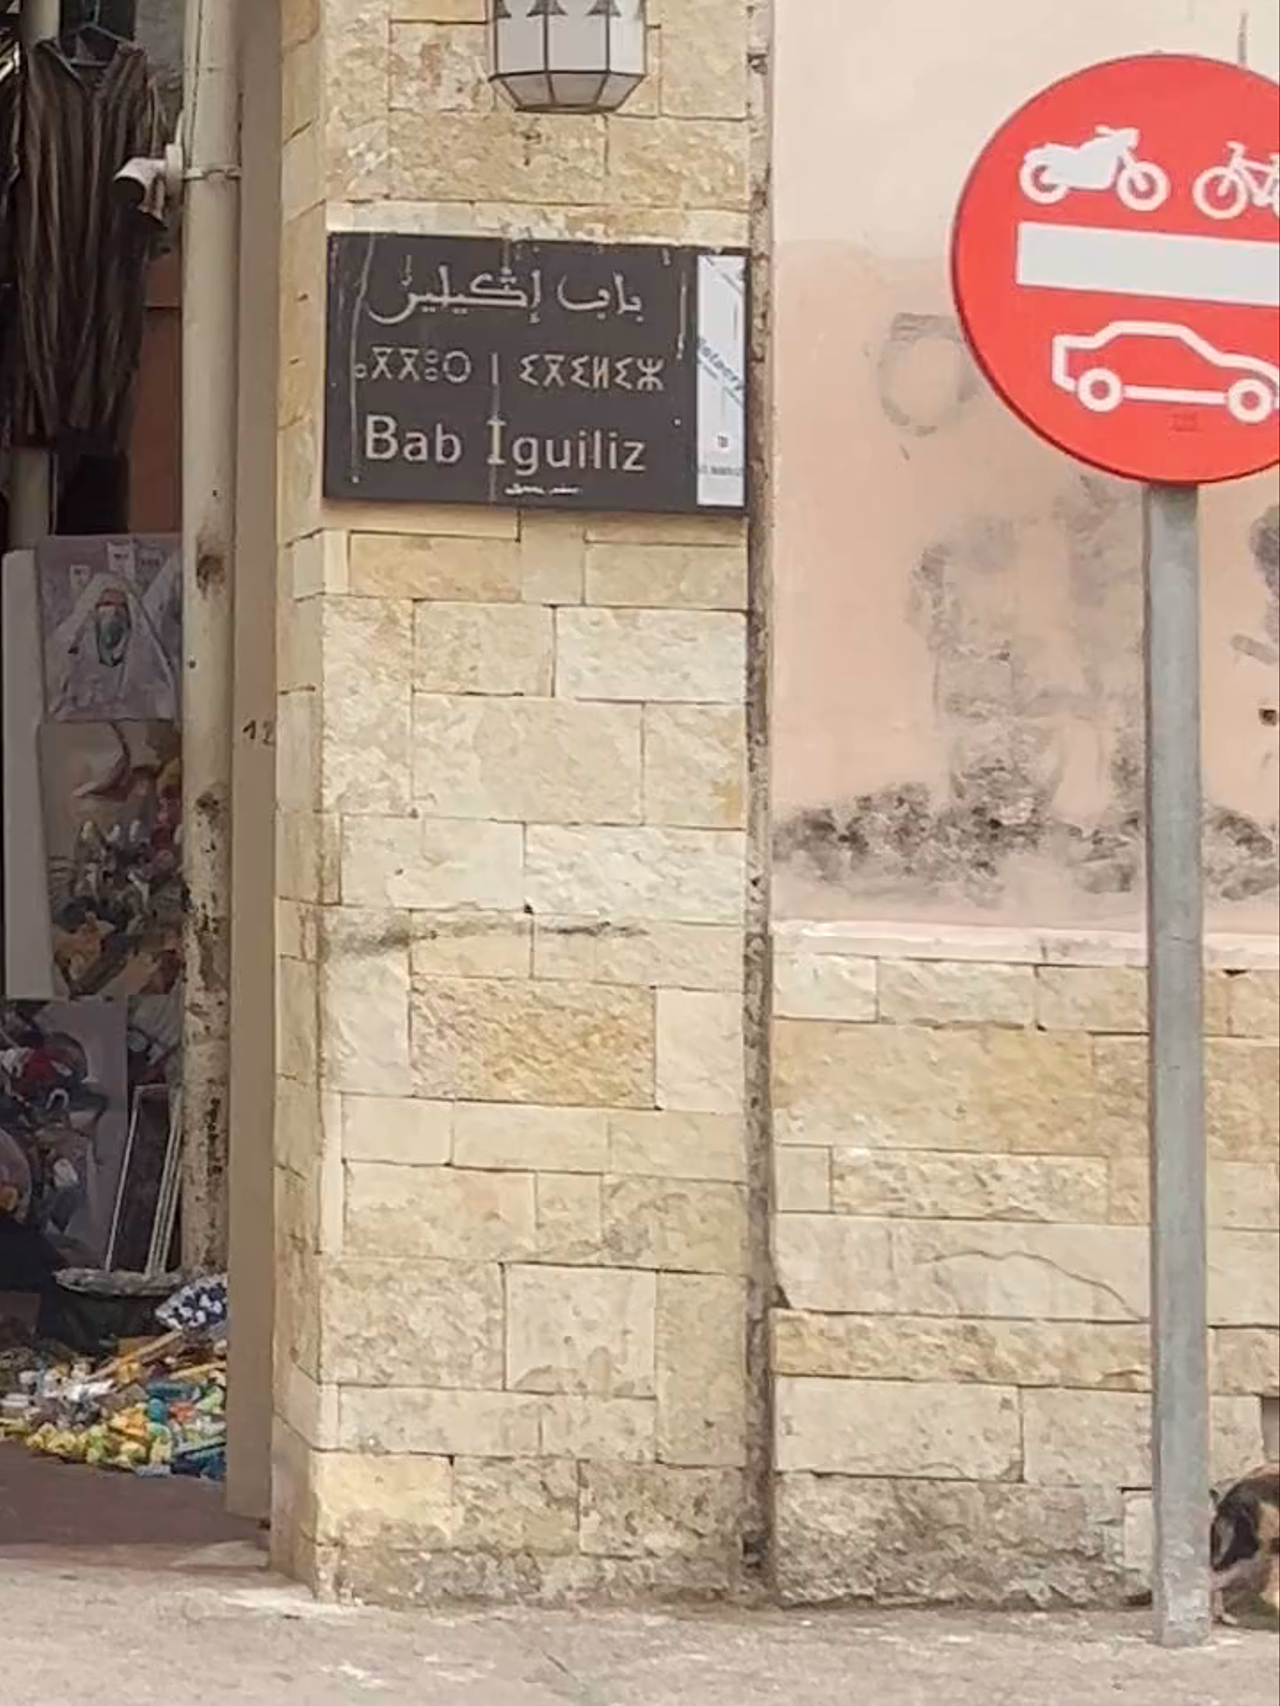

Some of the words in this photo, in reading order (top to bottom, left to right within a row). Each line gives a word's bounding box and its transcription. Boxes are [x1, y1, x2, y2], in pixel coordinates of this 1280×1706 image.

[557, 270, 644, 322] باب
[364, 415, 462, 464] Bab
[486, 418, 646, 476] Iguiliz
